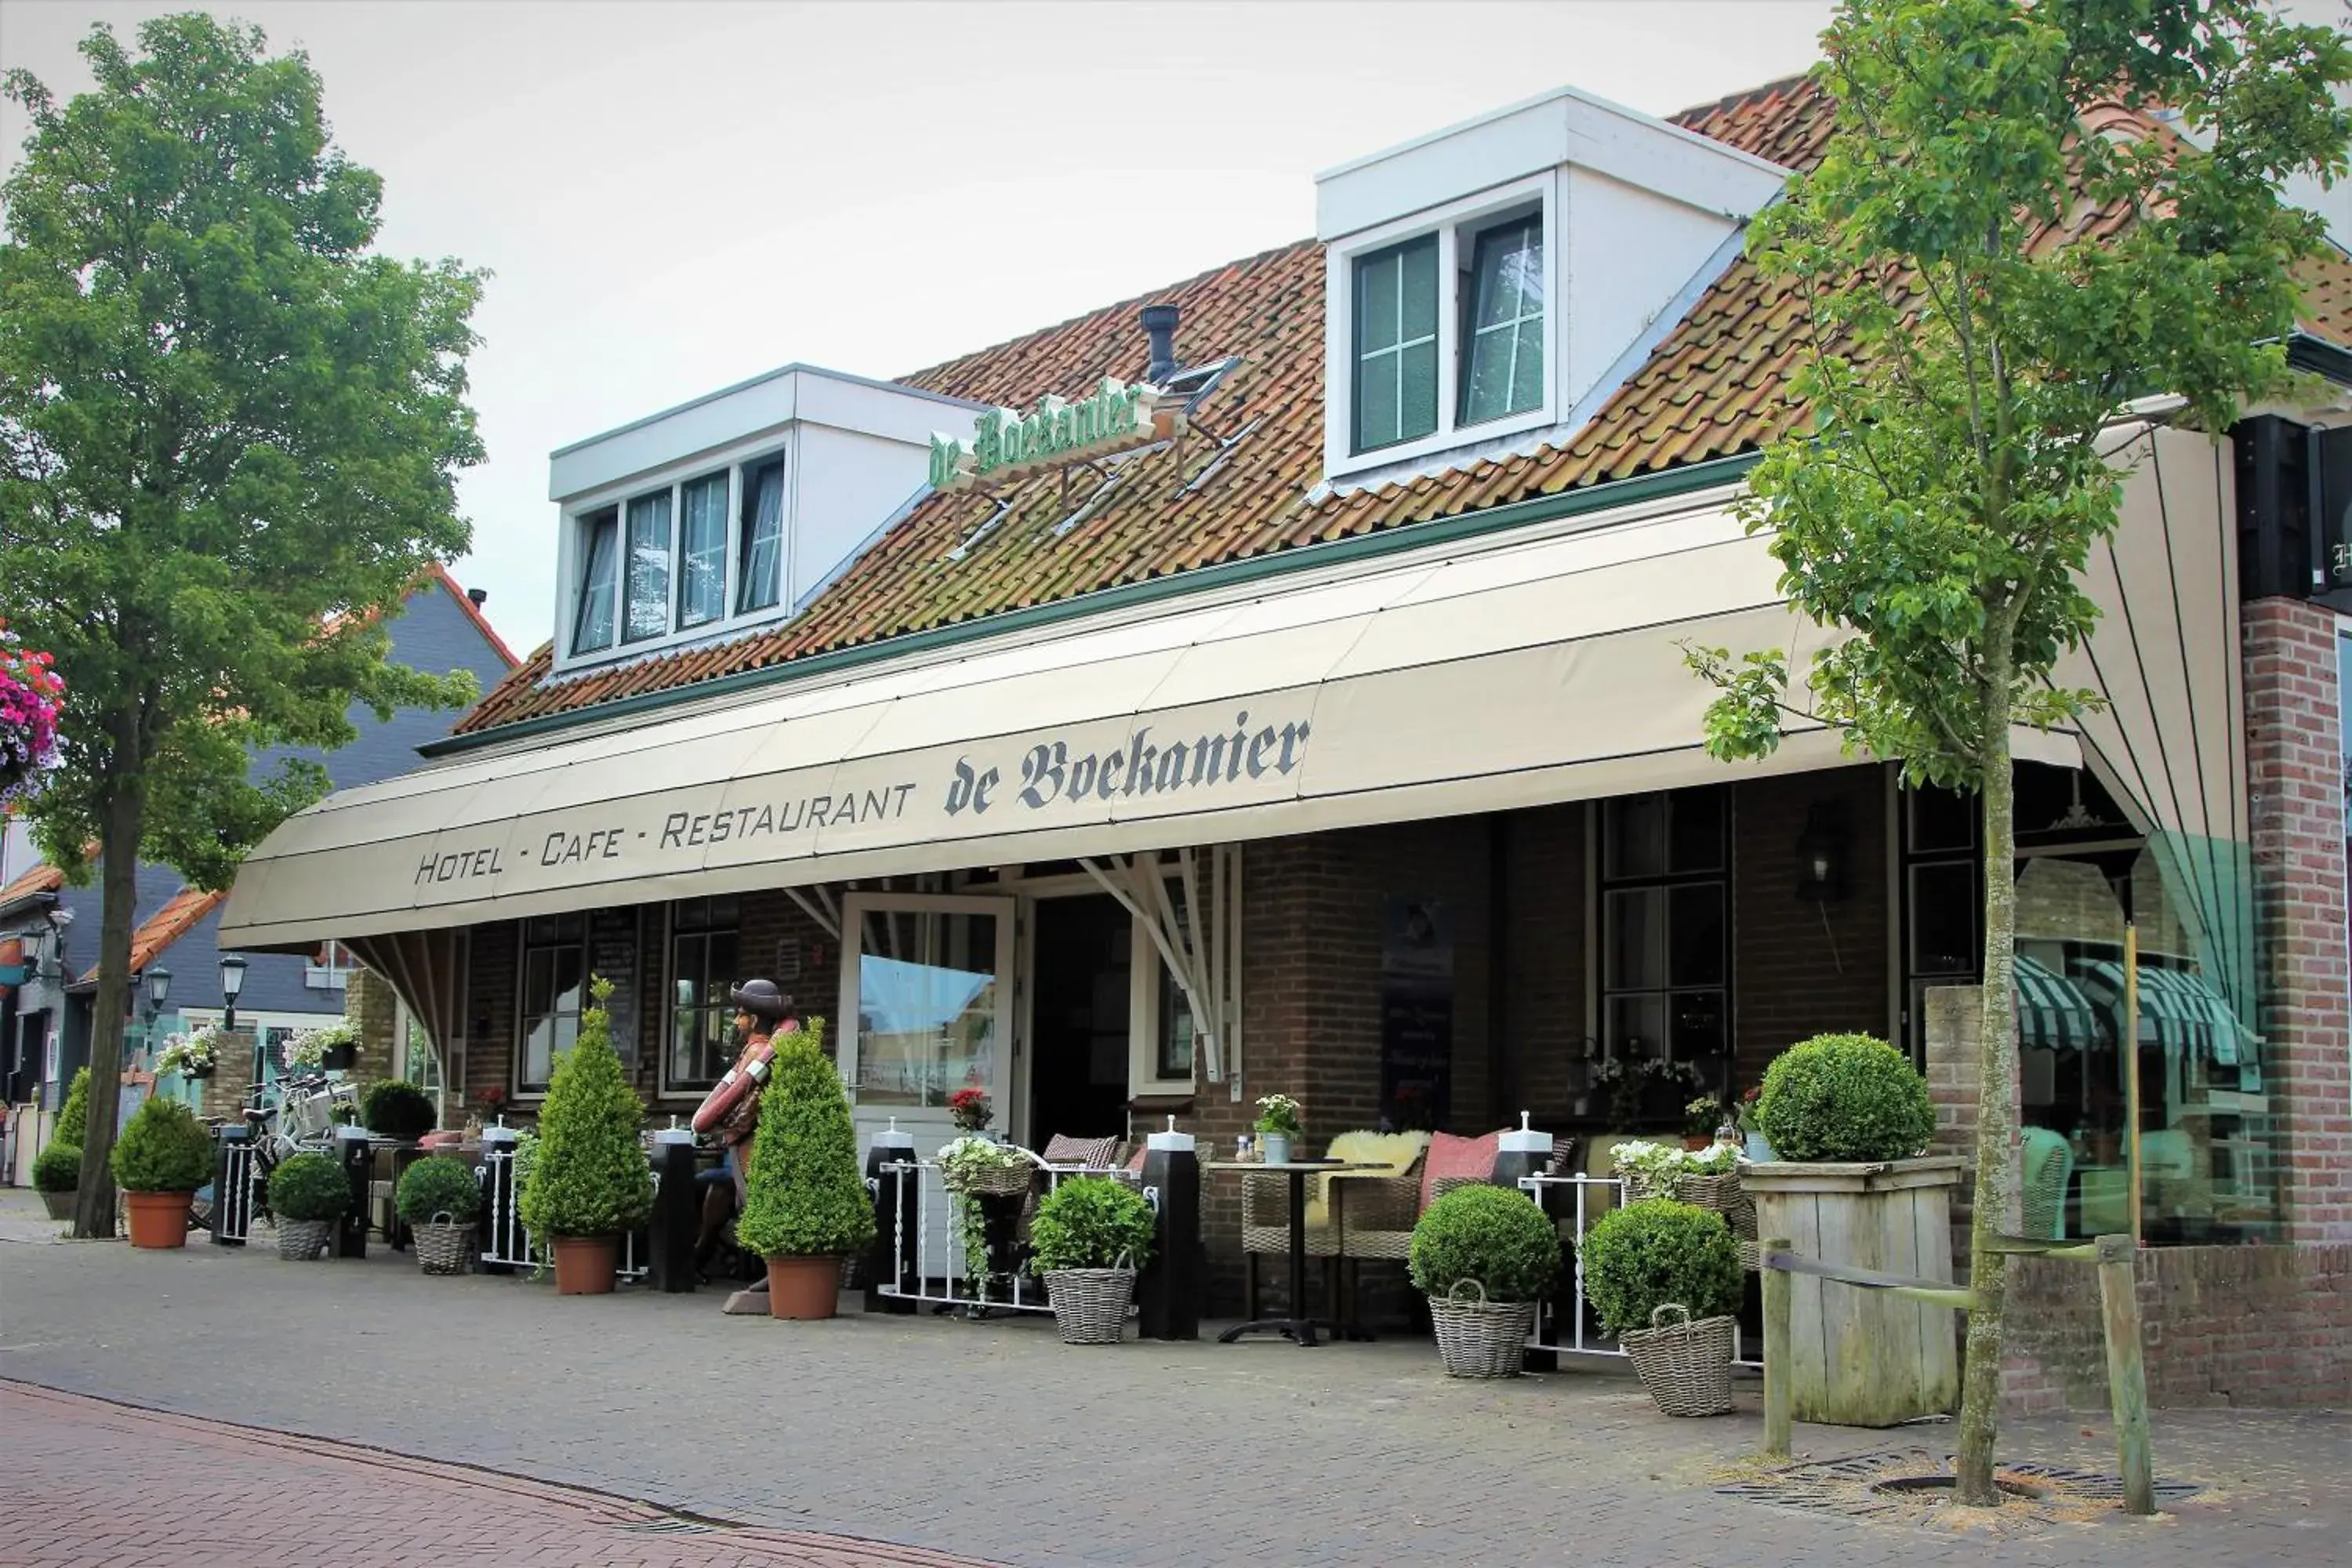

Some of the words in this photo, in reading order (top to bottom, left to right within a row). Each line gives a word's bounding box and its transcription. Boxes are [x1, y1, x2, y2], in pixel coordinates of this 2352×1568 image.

[414, 848, 503, 885] HOTEL
[540, 827, 625, 866] CAFE
[659, 783, 916, 849] RESTAURANT
[943, 753, 1000, 816] de
[1016, 710, 1310, 809] Boekanier
